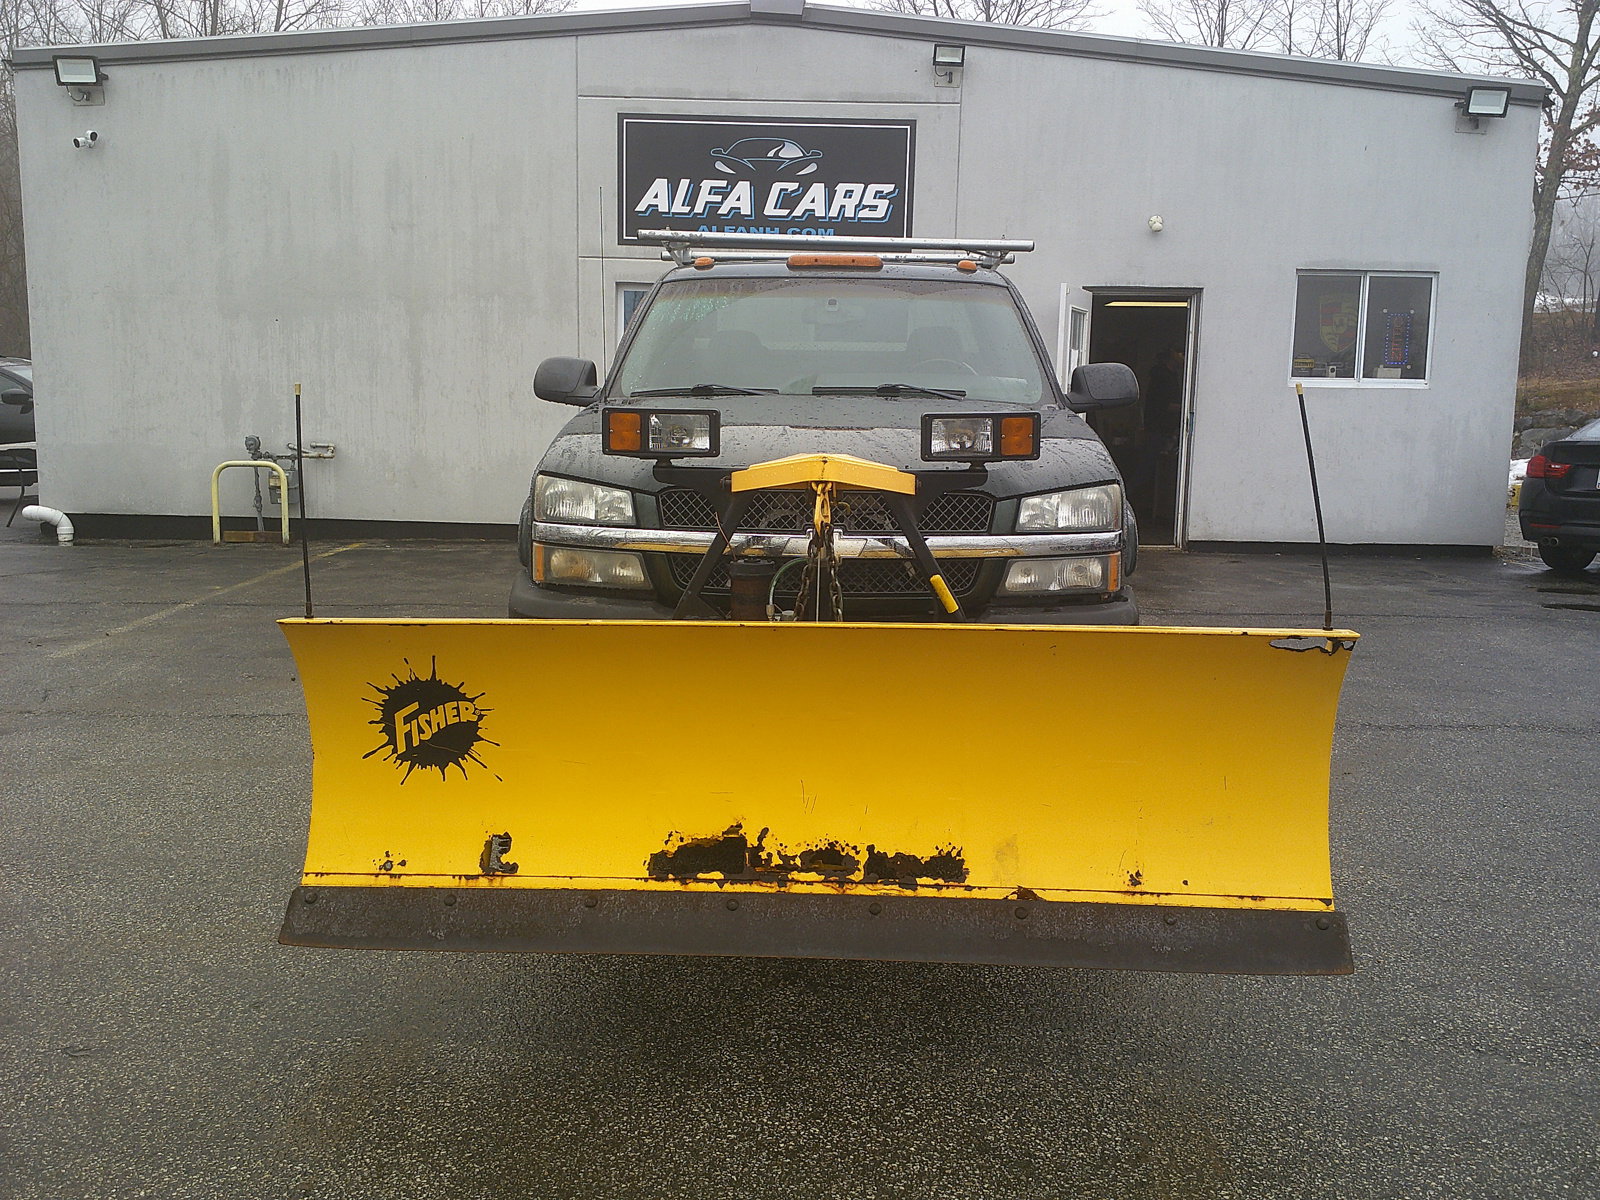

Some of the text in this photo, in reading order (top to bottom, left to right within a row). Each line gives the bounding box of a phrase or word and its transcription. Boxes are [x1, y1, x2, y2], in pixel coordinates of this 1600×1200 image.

[634, 178, 899, 223] ALFA CARS
[698, 225, 834, 236] ALFANHCOM
[395, 701, 478, 754] FISHER
